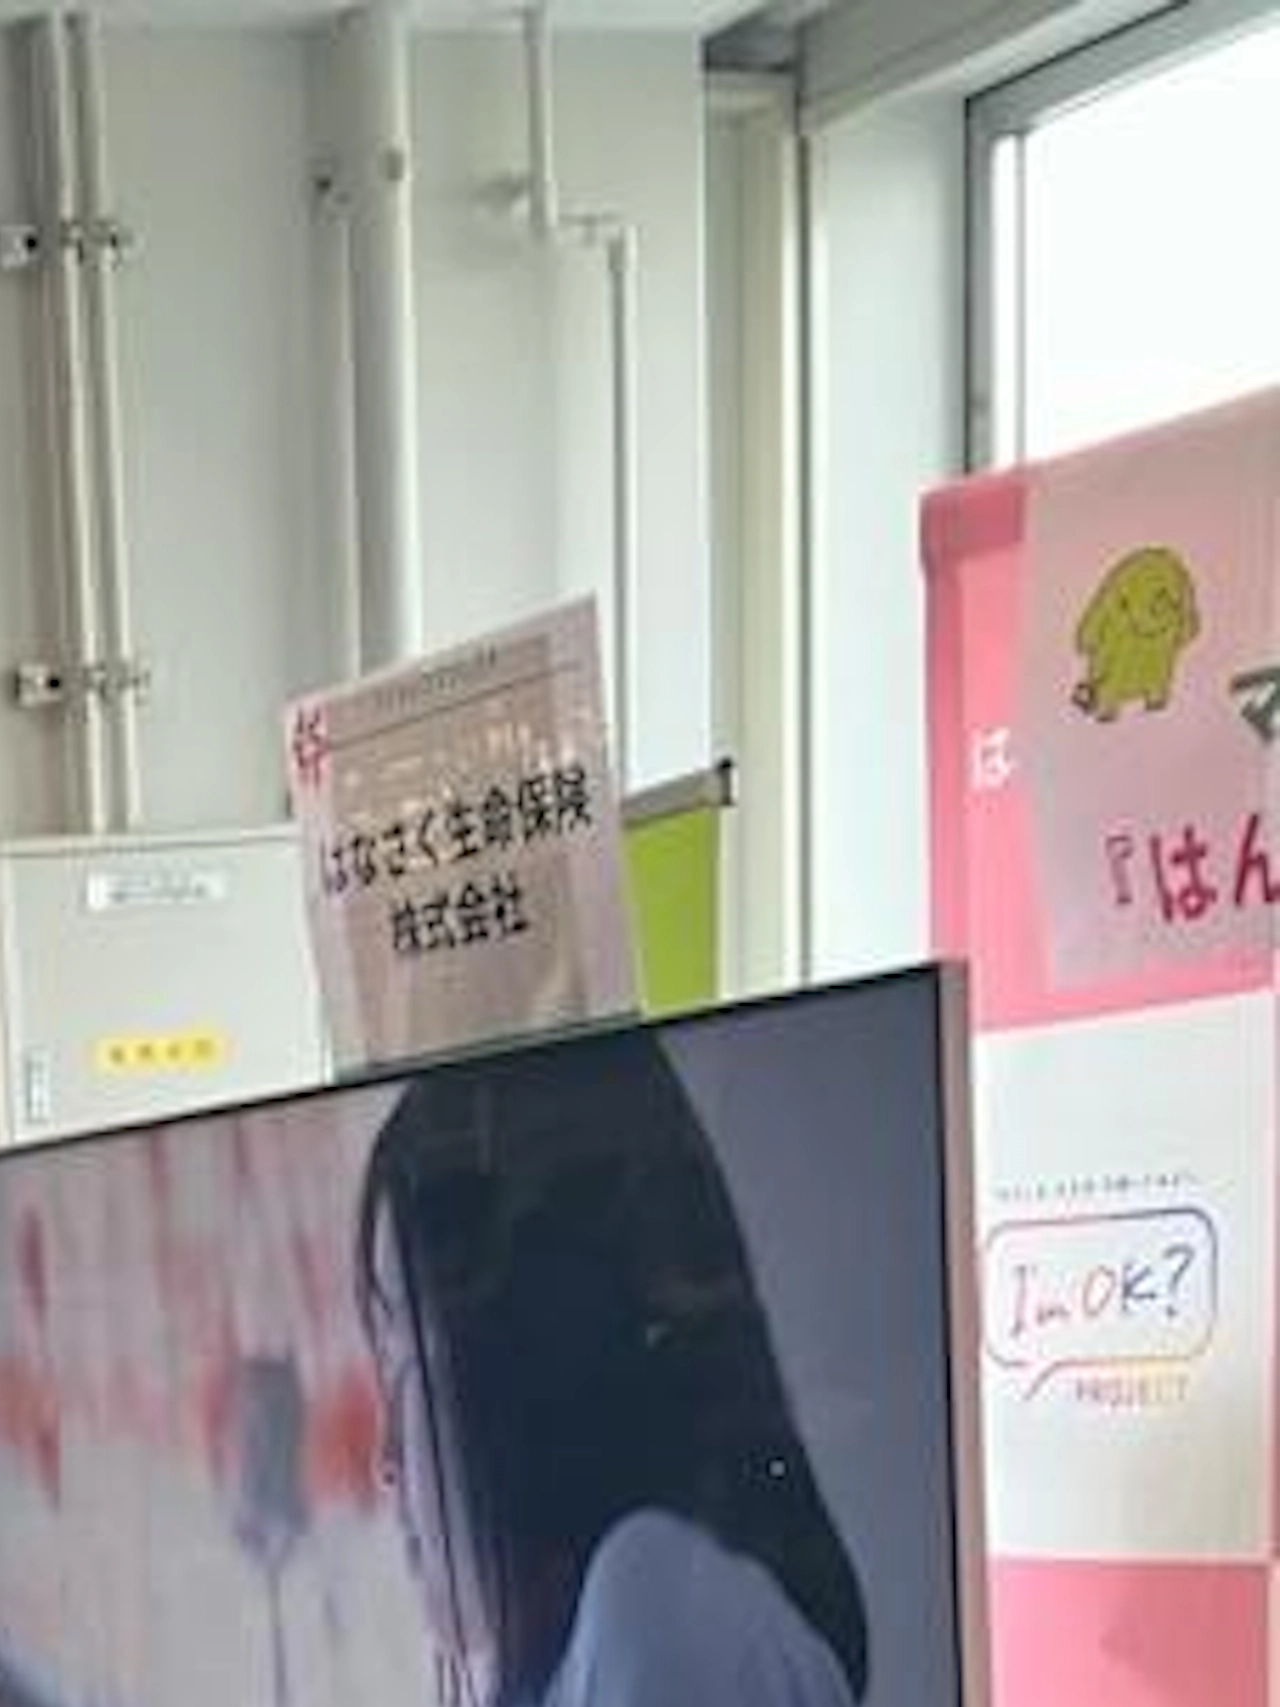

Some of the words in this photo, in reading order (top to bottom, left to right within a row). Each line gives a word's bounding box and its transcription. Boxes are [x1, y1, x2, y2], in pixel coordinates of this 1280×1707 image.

[321, 765, 593, 896] はなさく生命保険
[392, 872, 530, 956] 株式会社
